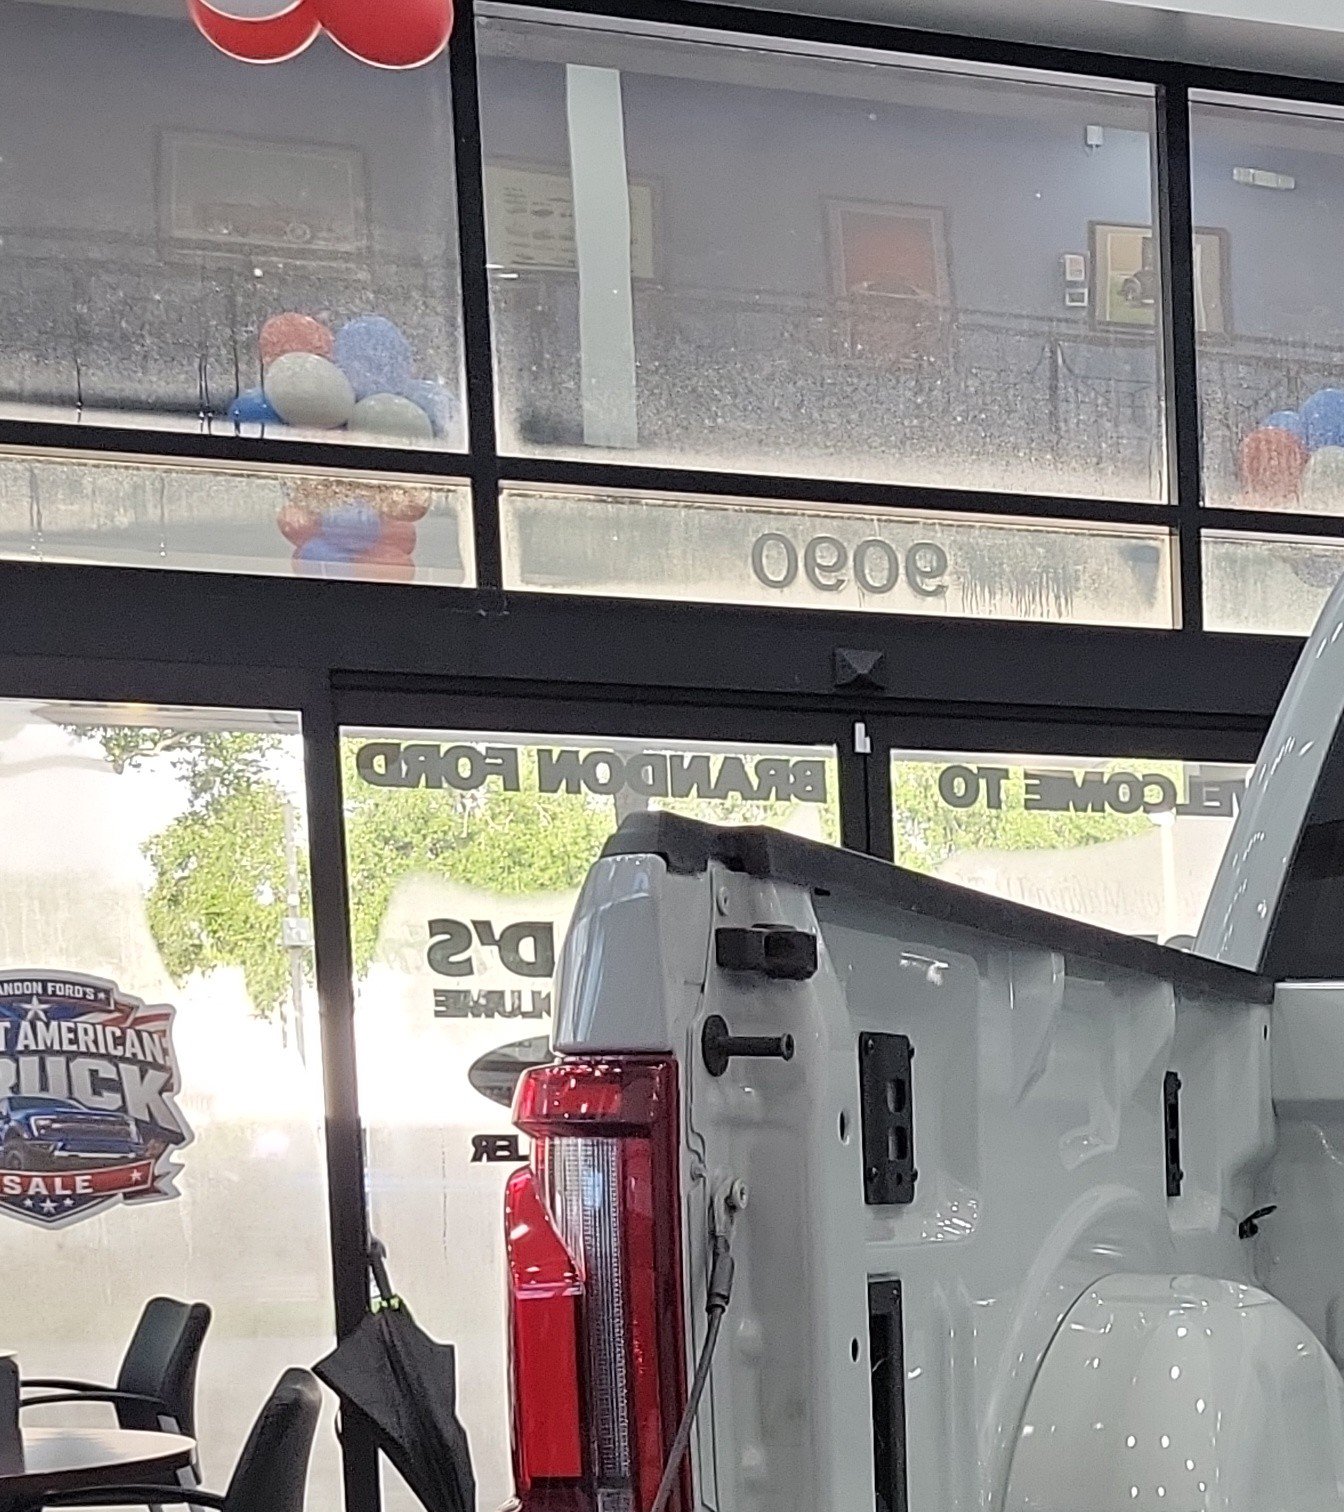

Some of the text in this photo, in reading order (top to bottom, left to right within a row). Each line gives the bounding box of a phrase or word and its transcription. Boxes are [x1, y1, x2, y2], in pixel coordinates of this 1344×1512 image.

[47, 982, 95, 1000] FORD'S
[16, 1021, 165, 1064] AMERICAN
[3, 1174, 94, 1196] SALE
